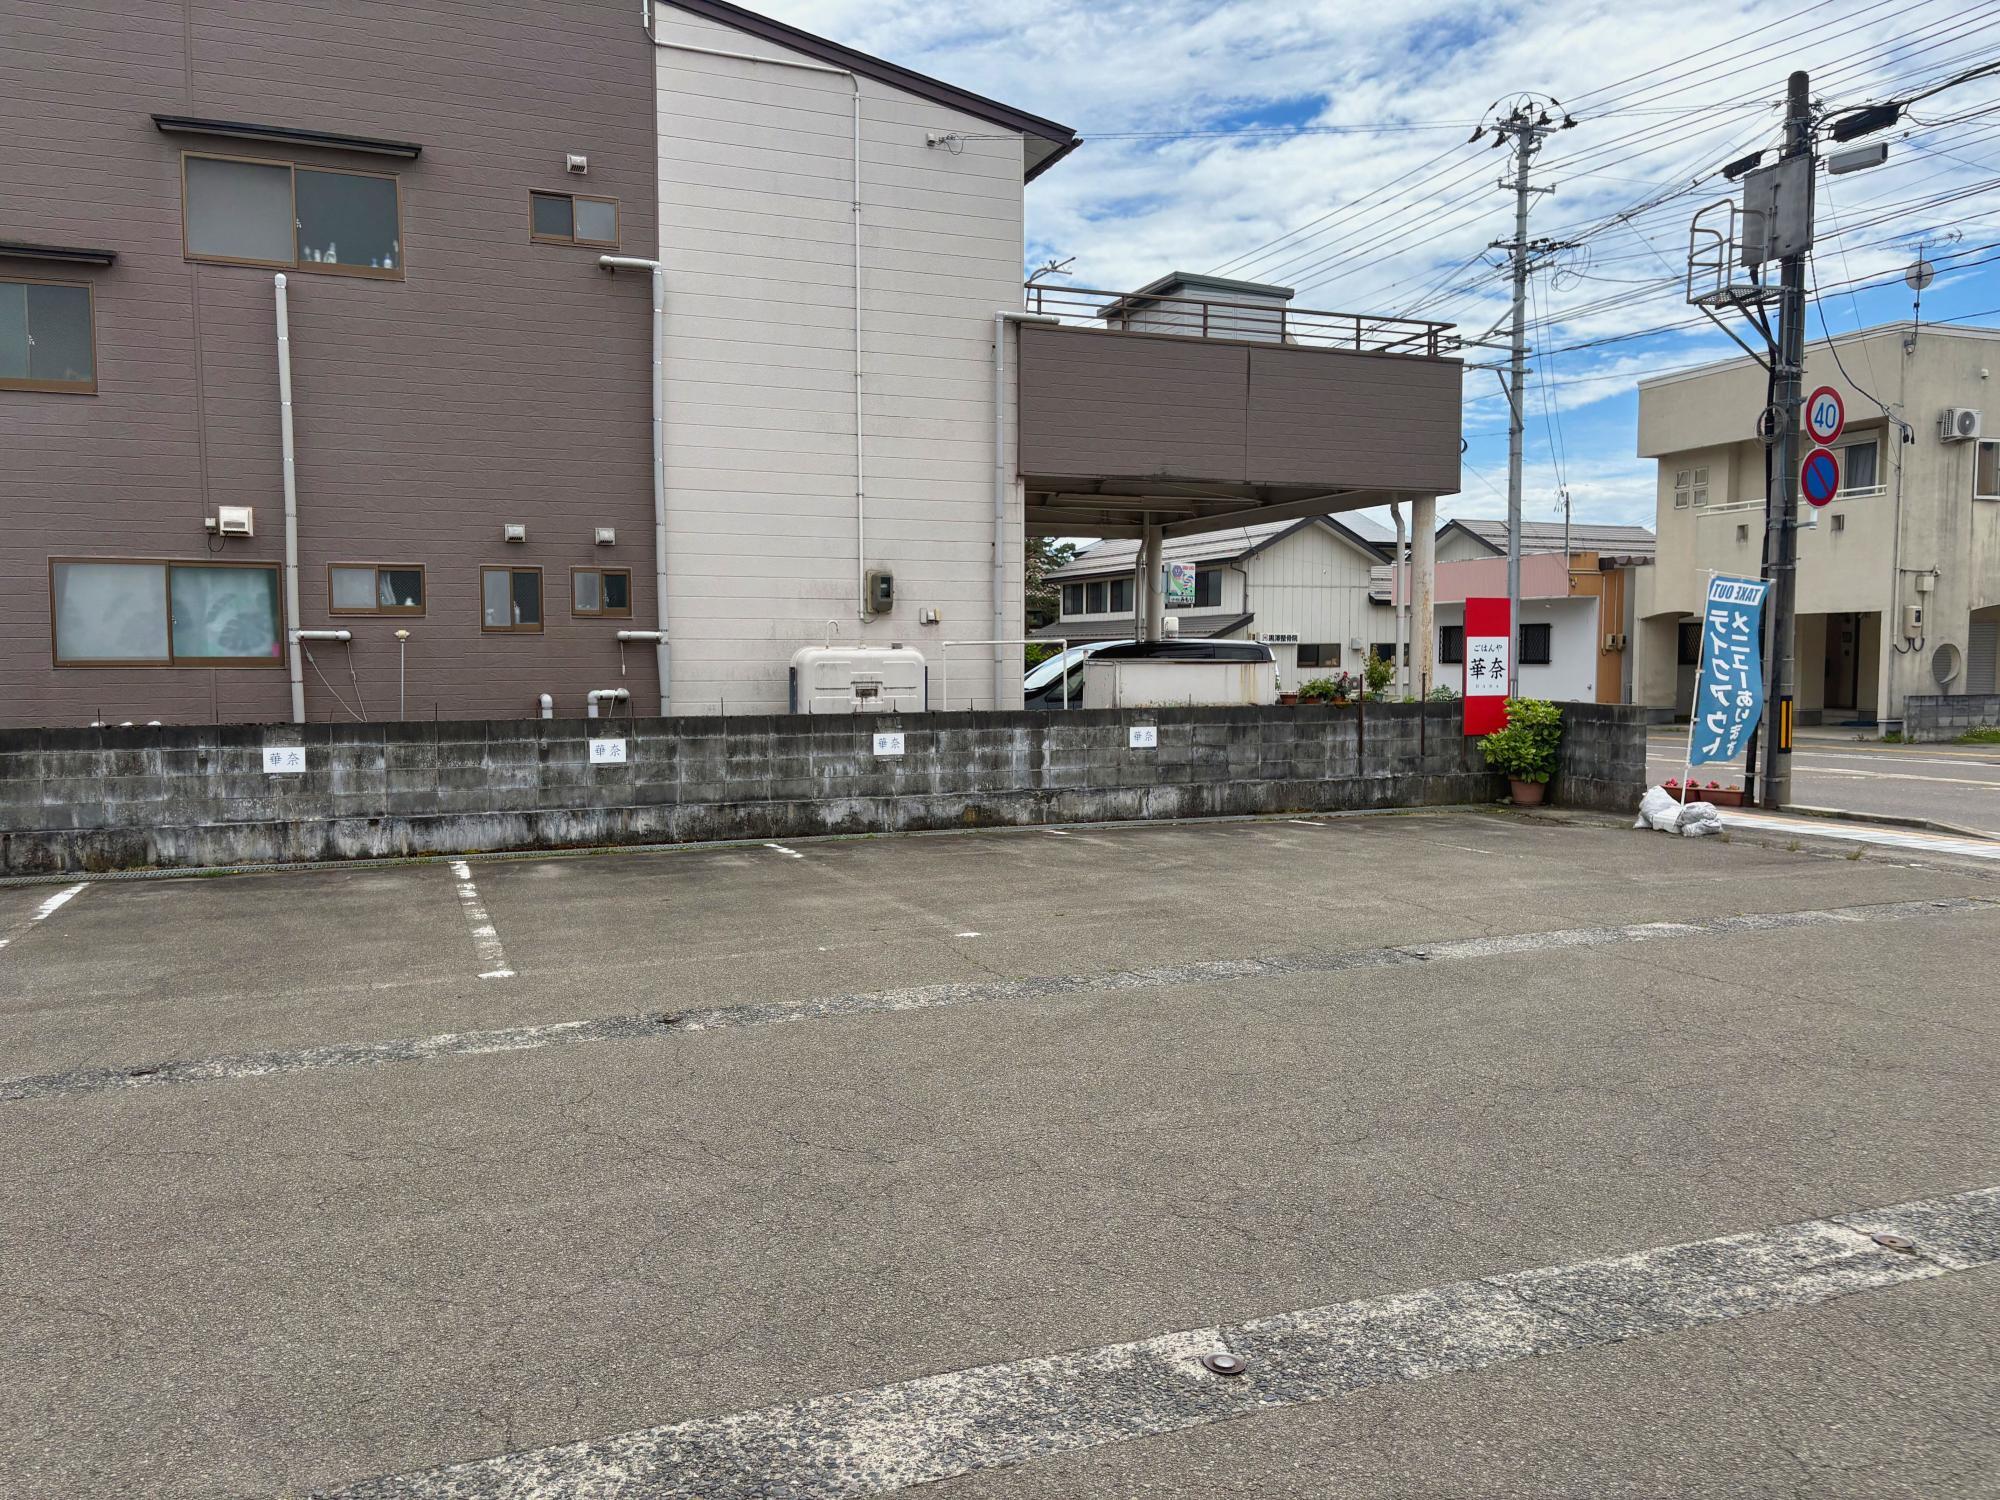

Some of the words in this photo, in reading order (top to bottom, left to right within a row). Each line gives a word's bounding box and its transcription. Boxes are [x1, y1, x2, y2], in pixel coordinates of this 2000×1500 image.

[1813, 402, 1837, 429] 40
[1474, 643, 1503, 652] ごはんや
[1470, 657, 1506, 680] 華奈
[594, 743, 621, 757] 華奈
[879, 736, 901, 750] 華奈
[269, 751, 300, 766] 華奈
